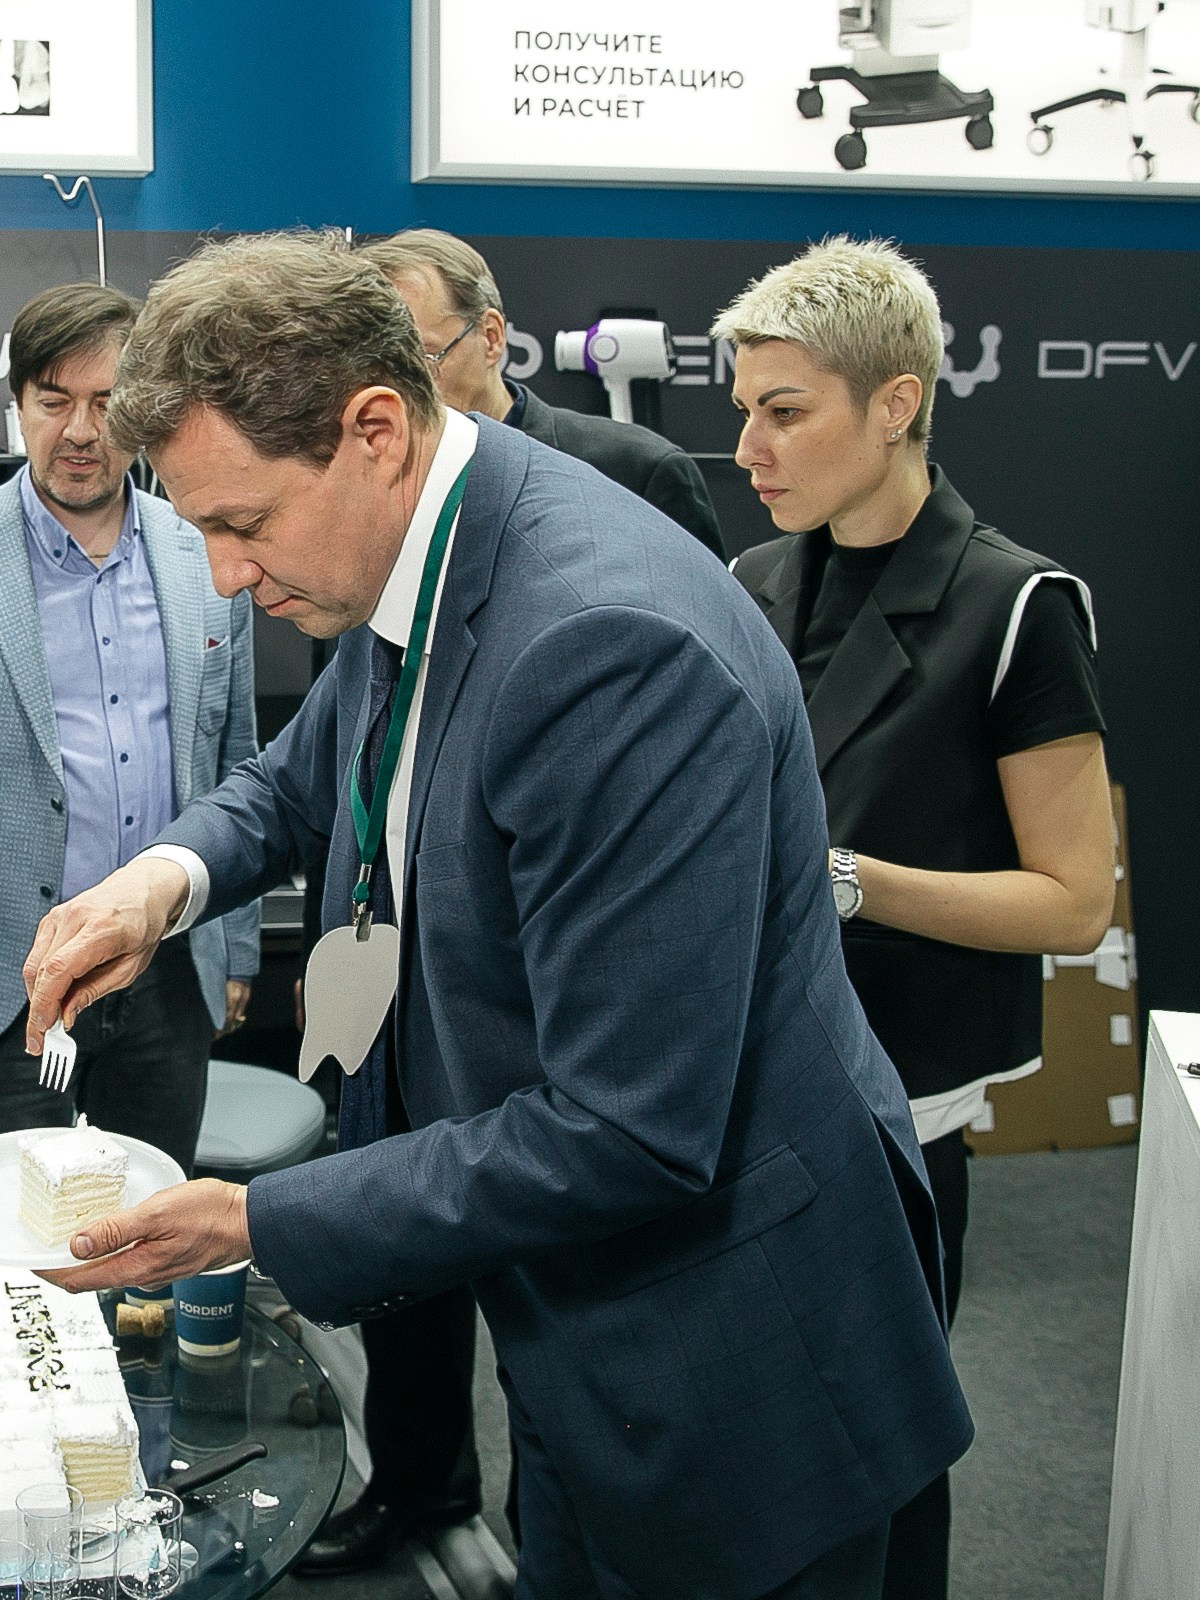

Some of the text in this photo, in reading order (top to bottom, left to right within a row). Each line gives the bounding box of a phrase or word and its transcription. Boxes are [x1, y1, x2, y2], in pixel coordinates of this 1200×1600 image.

[514, 30, 663, 54] ПОЛУЧИТЕ
[514, 63, 745, 91] КОНСУЛЬТАЦИЮ
[514, 94, 646, 119] И РАСЧЁТ
[179, 1299, 235, 1317] FORDENT
